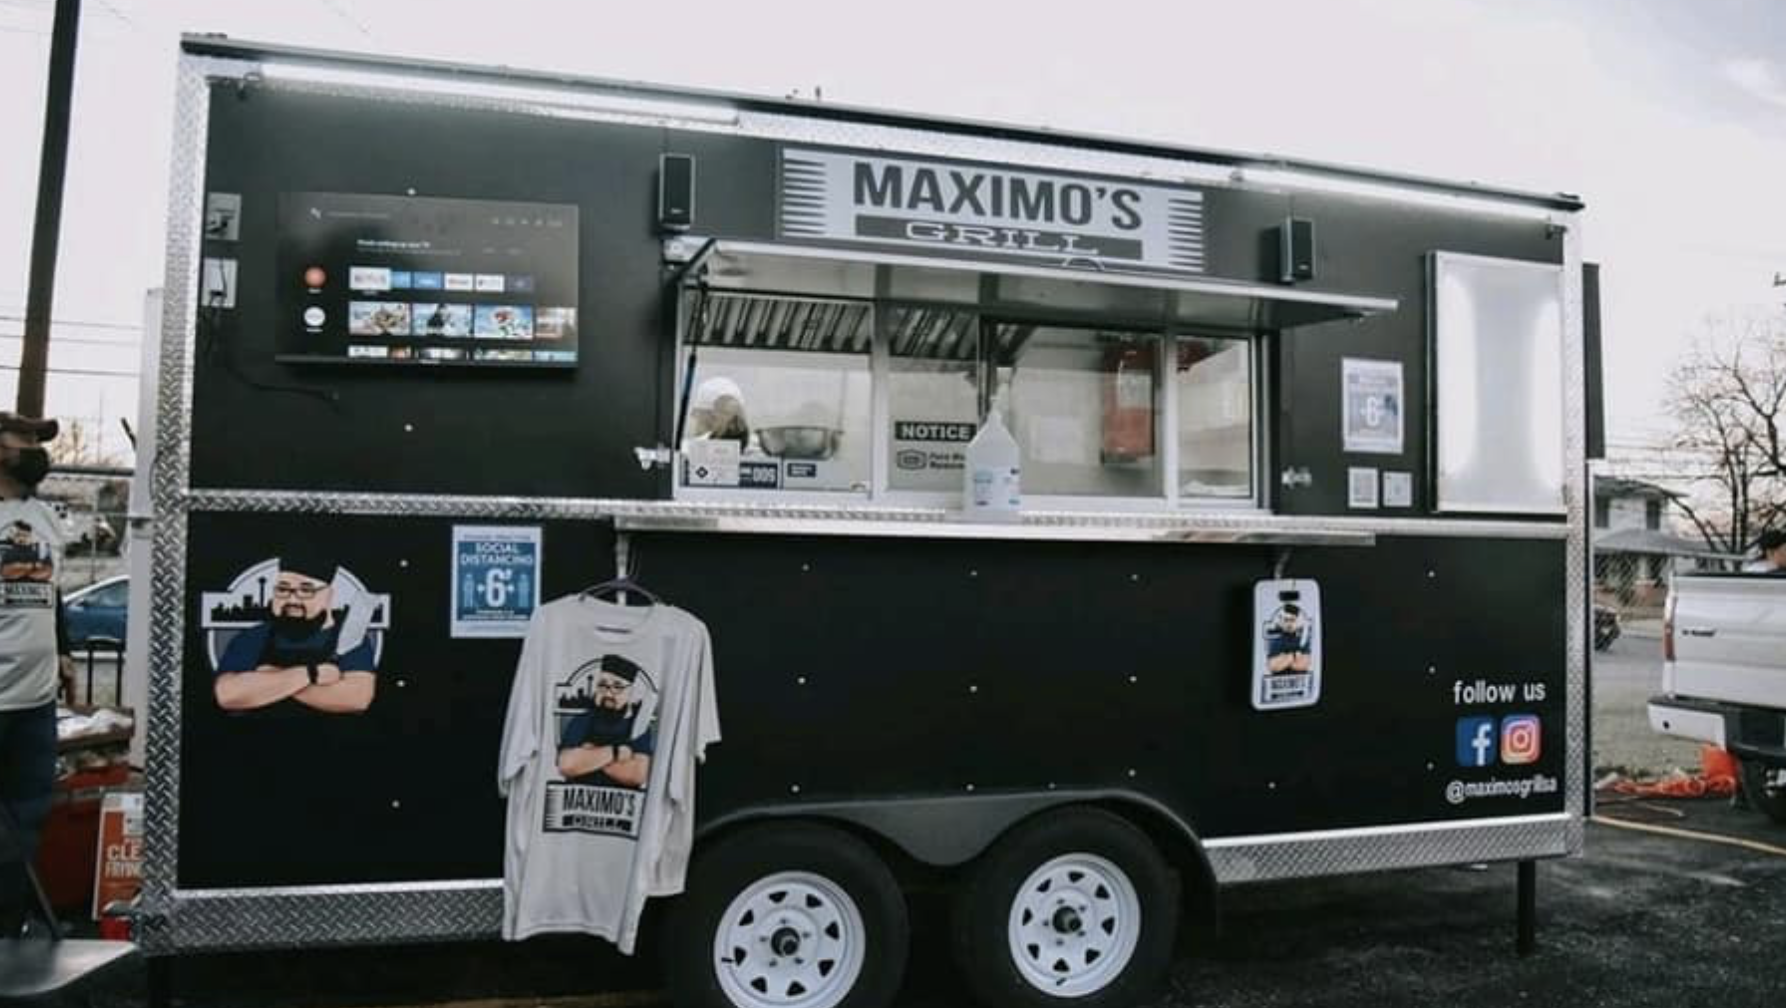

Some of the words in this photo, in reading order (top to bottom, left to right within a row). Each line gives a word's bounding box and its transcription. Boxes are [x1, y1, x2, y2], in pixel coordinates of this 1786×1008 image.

[853, 161, 1142, 231] MAXIMO'S
[905, 221, 1099, 256] GRILL
[902, 424, 970, 440] NOTICE
[476, 542, 517, 554] SOCIAL
[460, 553, 533, 566] DISTANCING
[1454, 680, 1516, 705] follow
[1524, 682, 1547, 702] us
[563, 787, 636, 817] MAXIMO'S
[107, 845, 141, 862] CLE
